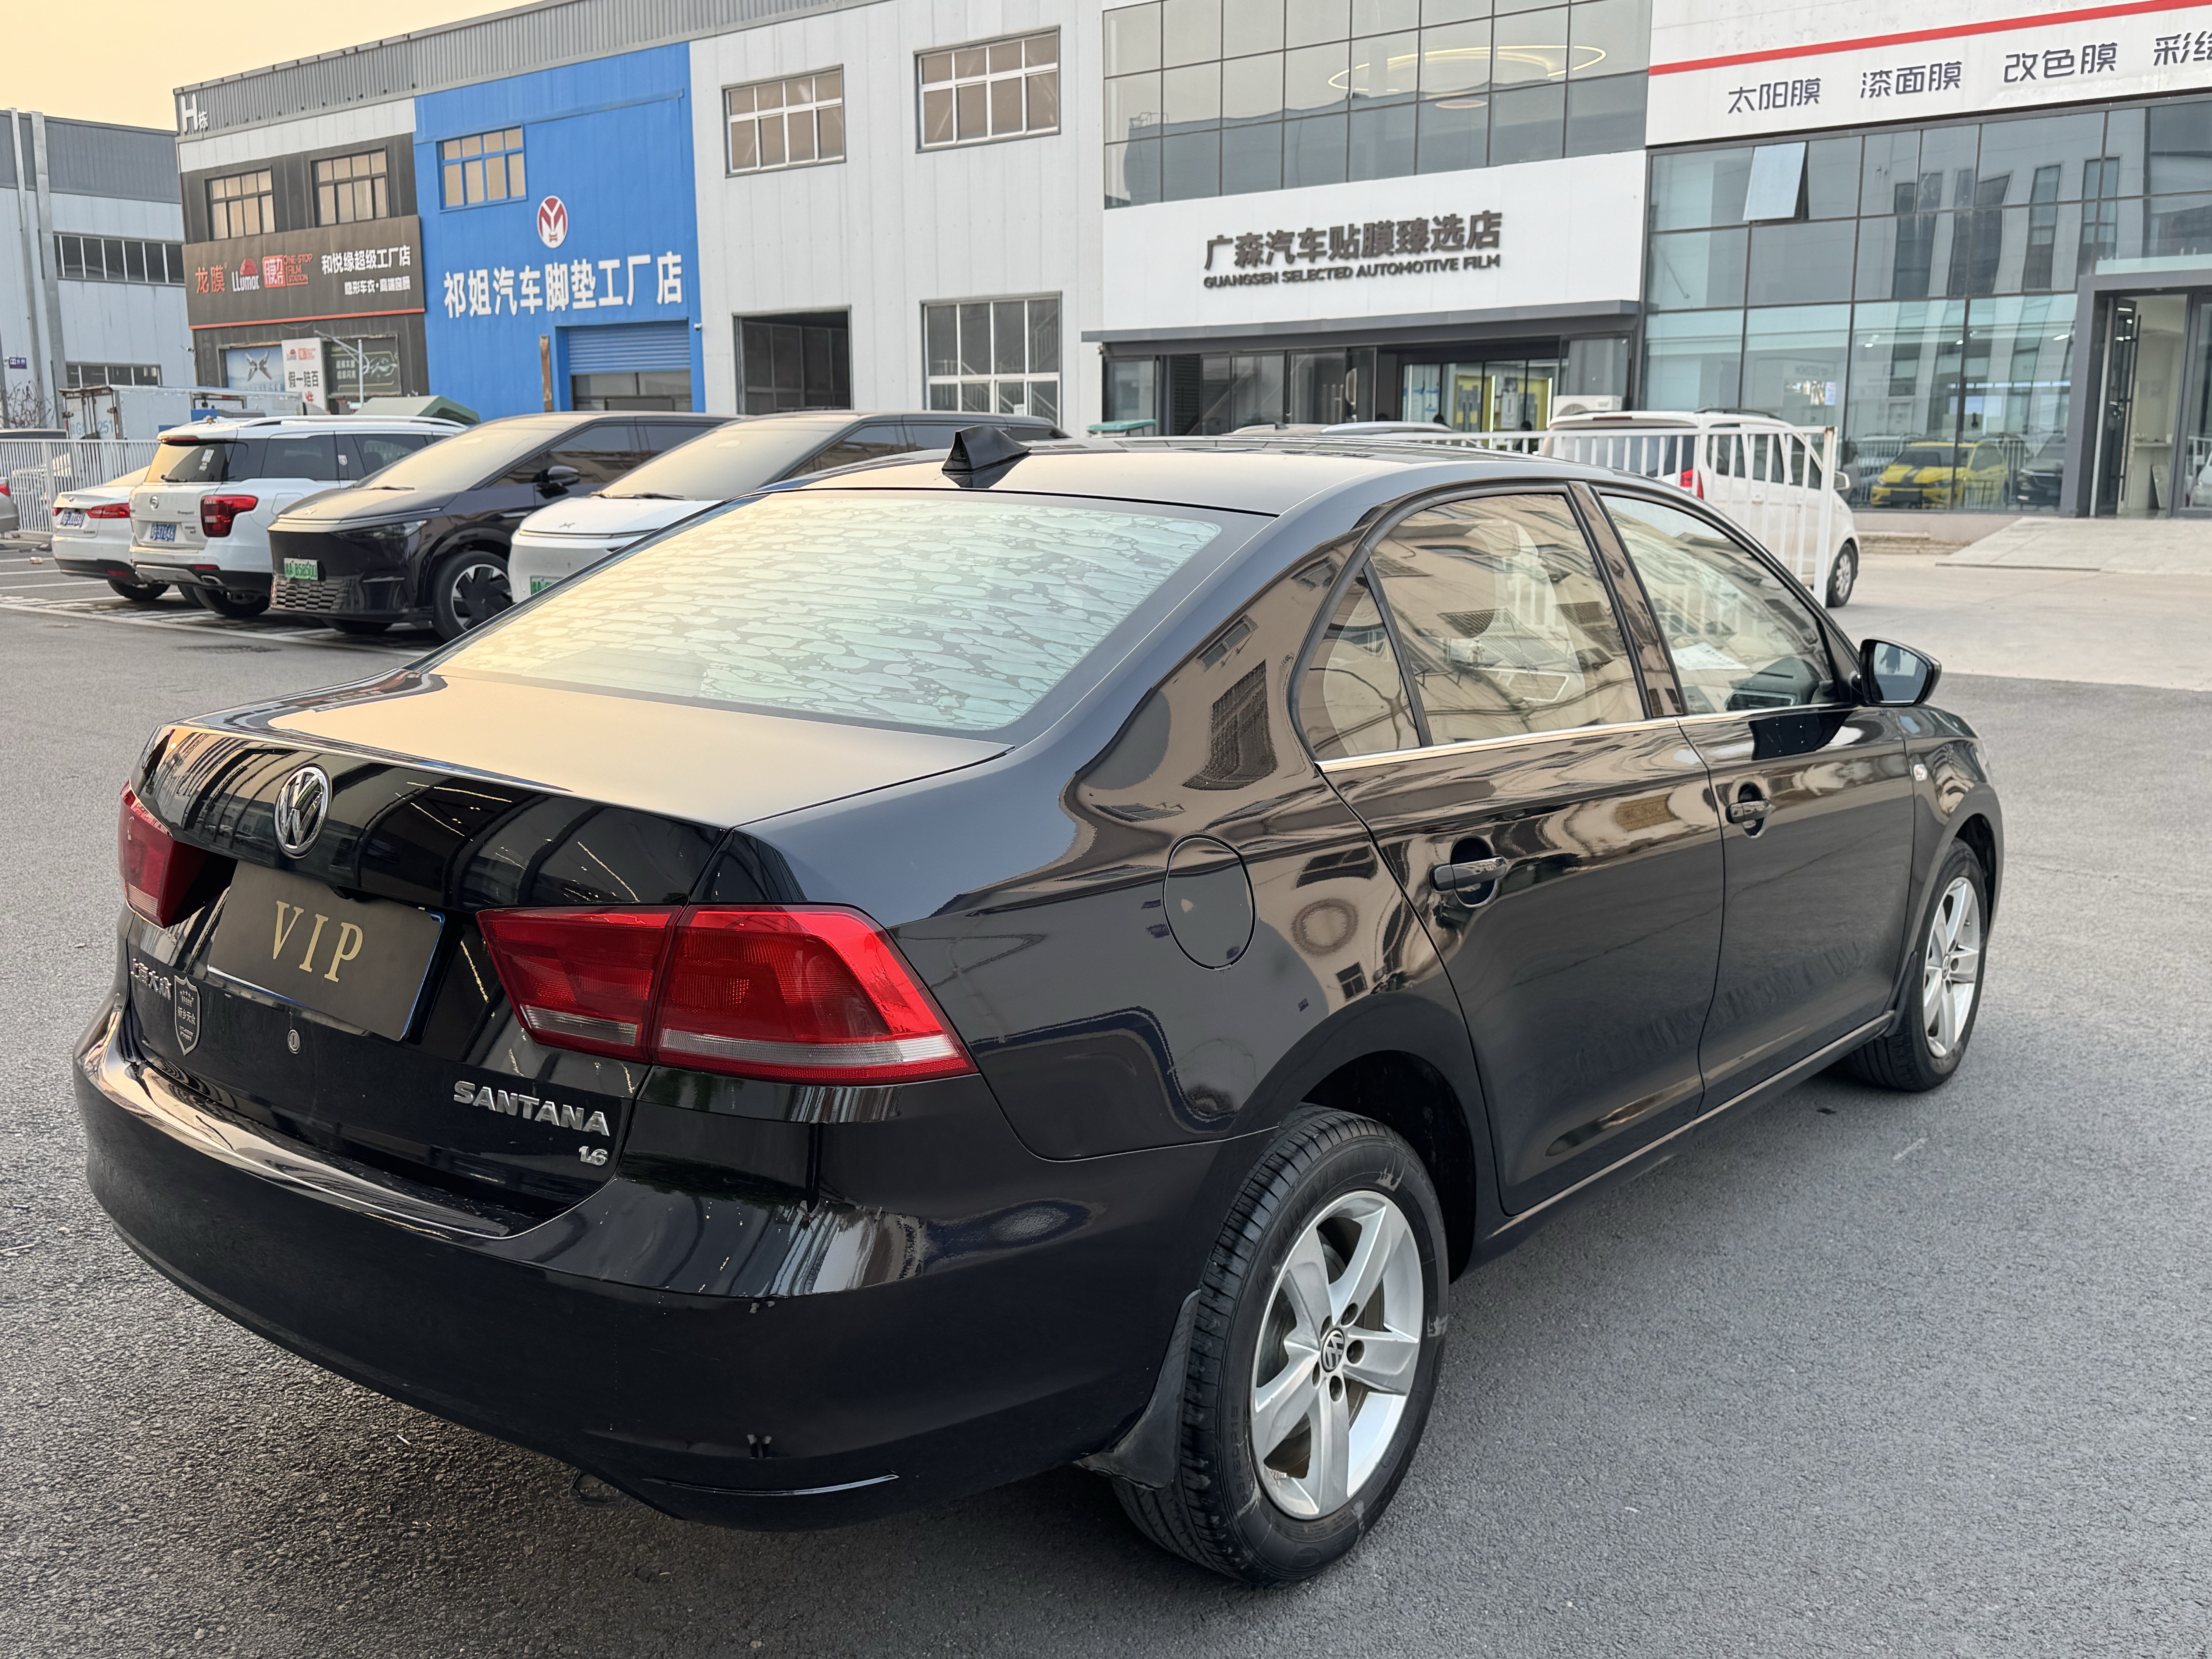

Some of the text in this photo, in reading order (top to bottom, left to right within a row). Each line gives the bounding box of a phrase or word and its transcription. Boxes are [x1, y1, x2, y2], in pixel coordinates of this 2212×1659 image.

[1860, 61, 1963, 99] 漆面膜
[2003, 42, 2118, 84] 改色膜
[1728, 77, 1822, 115] 太阳膜
[1204, 210, 1502, 270] 广森汽车贴膜臻选店
[288, 264, 302, 275] FILM
[321, 245, 411, 275] 和悦缘超级工厂店
[1204, 254, 1500, 288] GUANGSEN SELECTED AUTOMOTIVE FILM
[195, 265, 225, 294] 龙膜
[444, 251, 683, 318] 祁姐汽车脚垫工厂店
[272, 900, 364, 983] VIP
[453, 1080, 610, 1137] SANTANA
